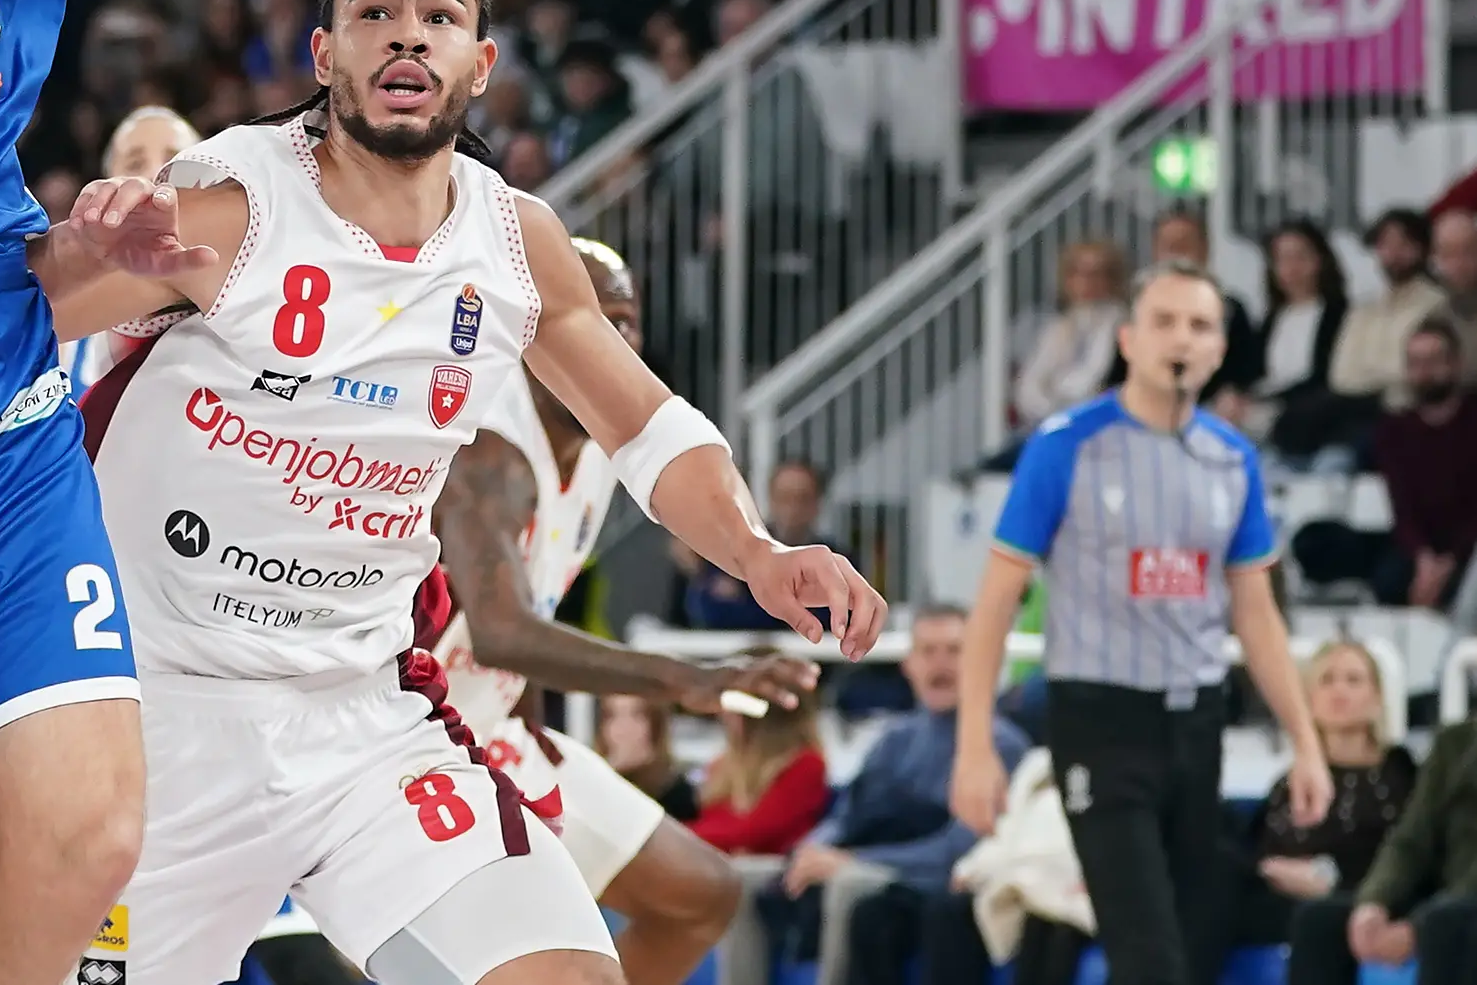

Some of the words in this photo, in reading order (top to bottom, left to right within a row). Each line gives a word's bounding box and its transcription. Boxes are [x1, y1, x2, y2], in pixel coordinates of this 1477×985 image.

[272, 264, 332, 358] 8
[456, 312, 478, 328] LBA
[332, 375, 381, 402] TCI
[290, 486, 323, 514] by
[362, 504, 423, 538] crit
[219, 546, 384, 589] motorola
[65, 564, 122, 650] 2
[213, 593, 303, 628] ITELYUM
[405, 773, 476, 842] 8
